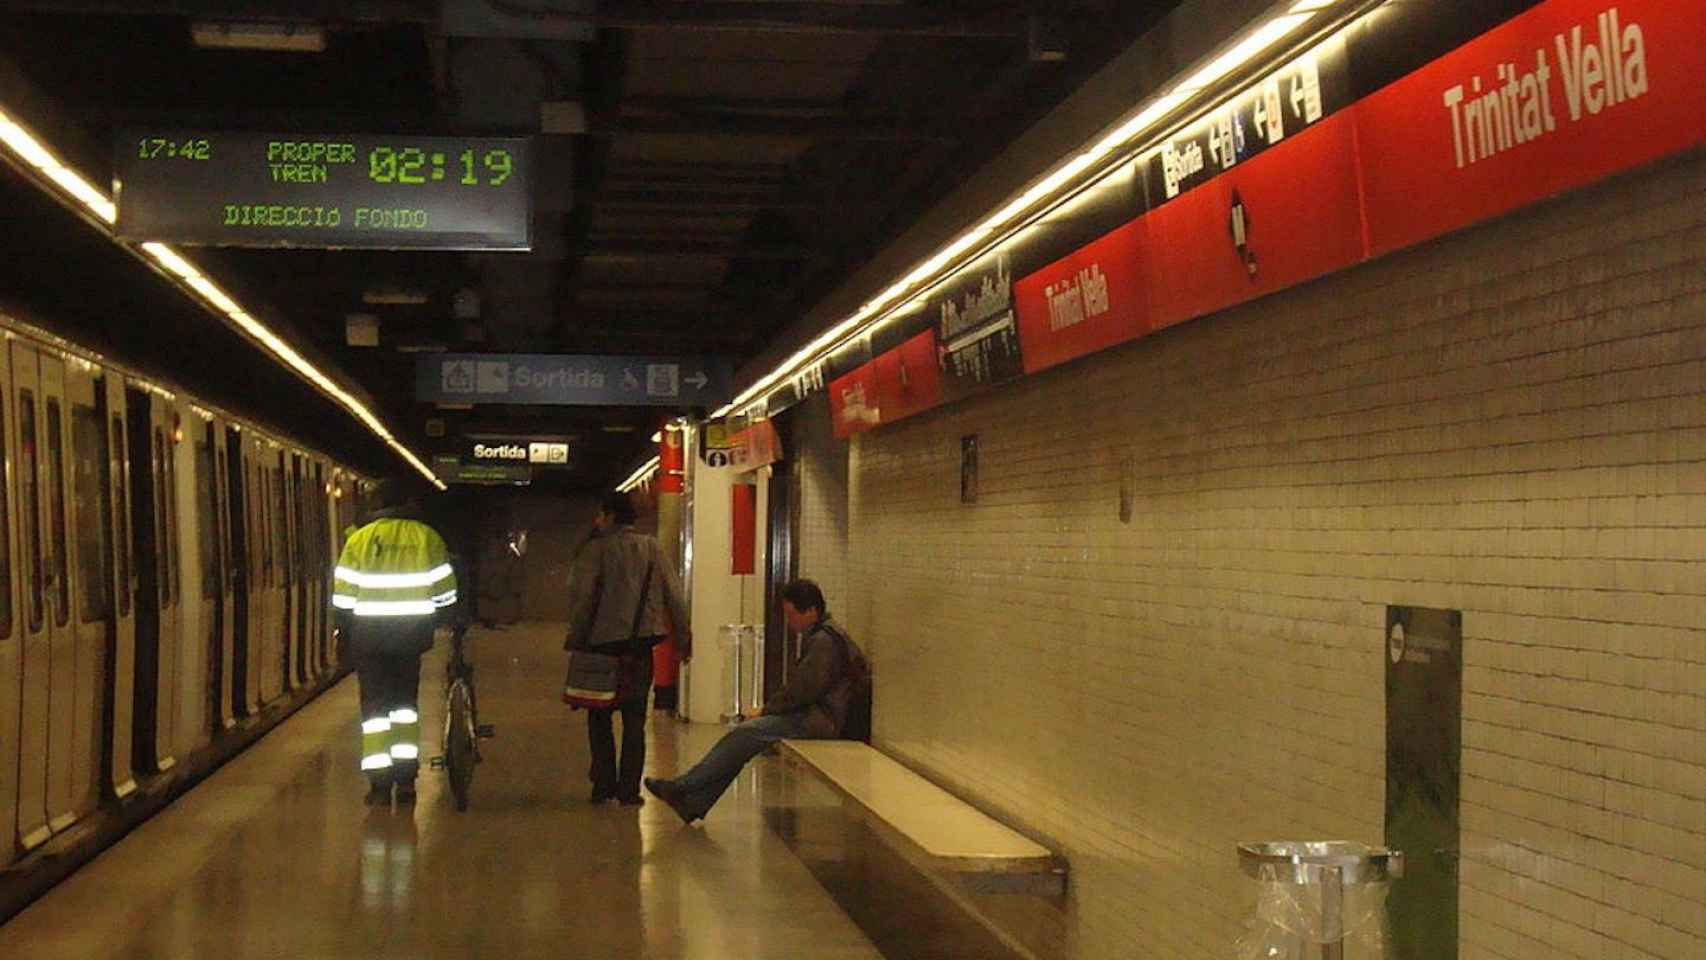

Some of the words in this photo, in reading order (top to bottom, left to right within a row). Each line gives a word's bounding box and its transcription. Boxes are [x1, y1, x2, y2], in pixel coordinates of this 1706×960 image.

[1443, 48, 1556, 168] Trinitat
[1556, 8, 1648, 121] Vella
[138, 139, 210, 160] 17:42
[267, 142, 356, 164] PROPER
[270, 164, 328, 182] TREN
[369, 146, 513, 185] 02:19
[354, 208, 429, 229] FONDO
[514, 367, 605, 388] Sortida
[474, 444, 527, 459] Sortida
